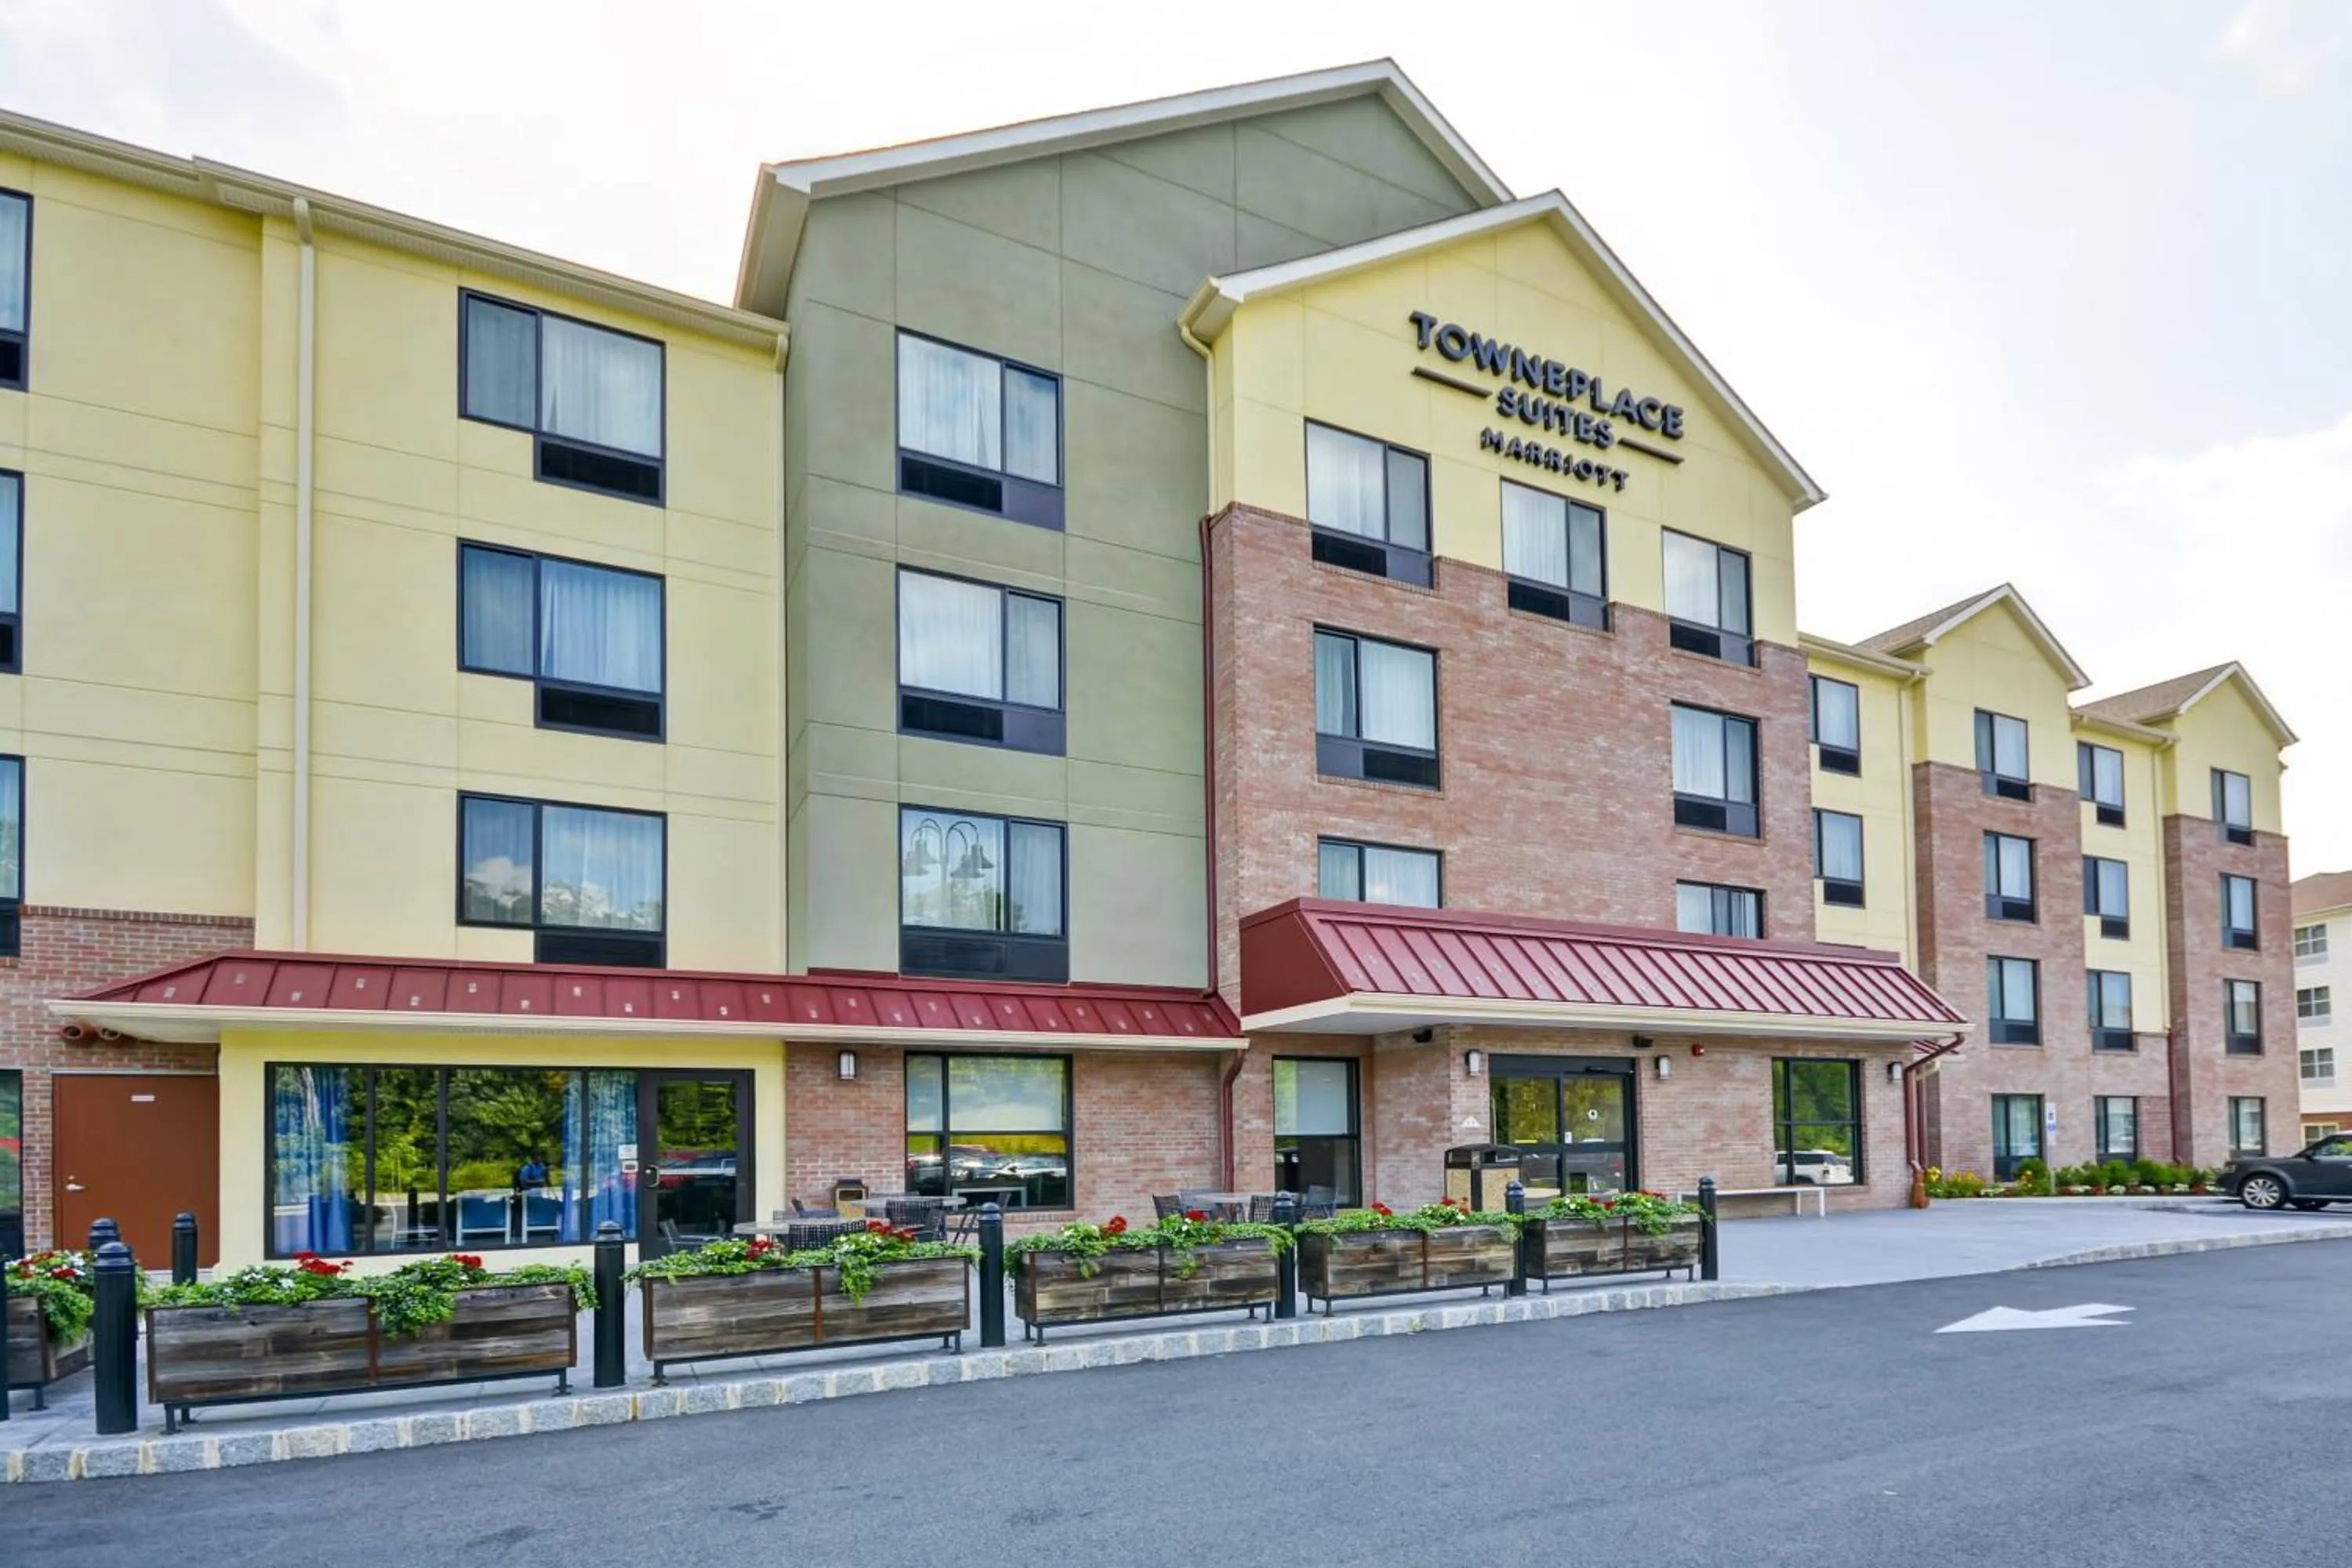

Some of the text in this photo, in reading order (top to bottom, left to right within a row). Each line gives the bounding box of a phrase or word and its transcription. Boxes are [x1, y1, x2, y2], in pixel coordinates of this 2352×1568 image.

[1410, 310, 1684, 439] TOWNEPLACE
[1497, 387, 1615, 449] SUITES
[1480, 426, 1629, 492] MARRIOTT
